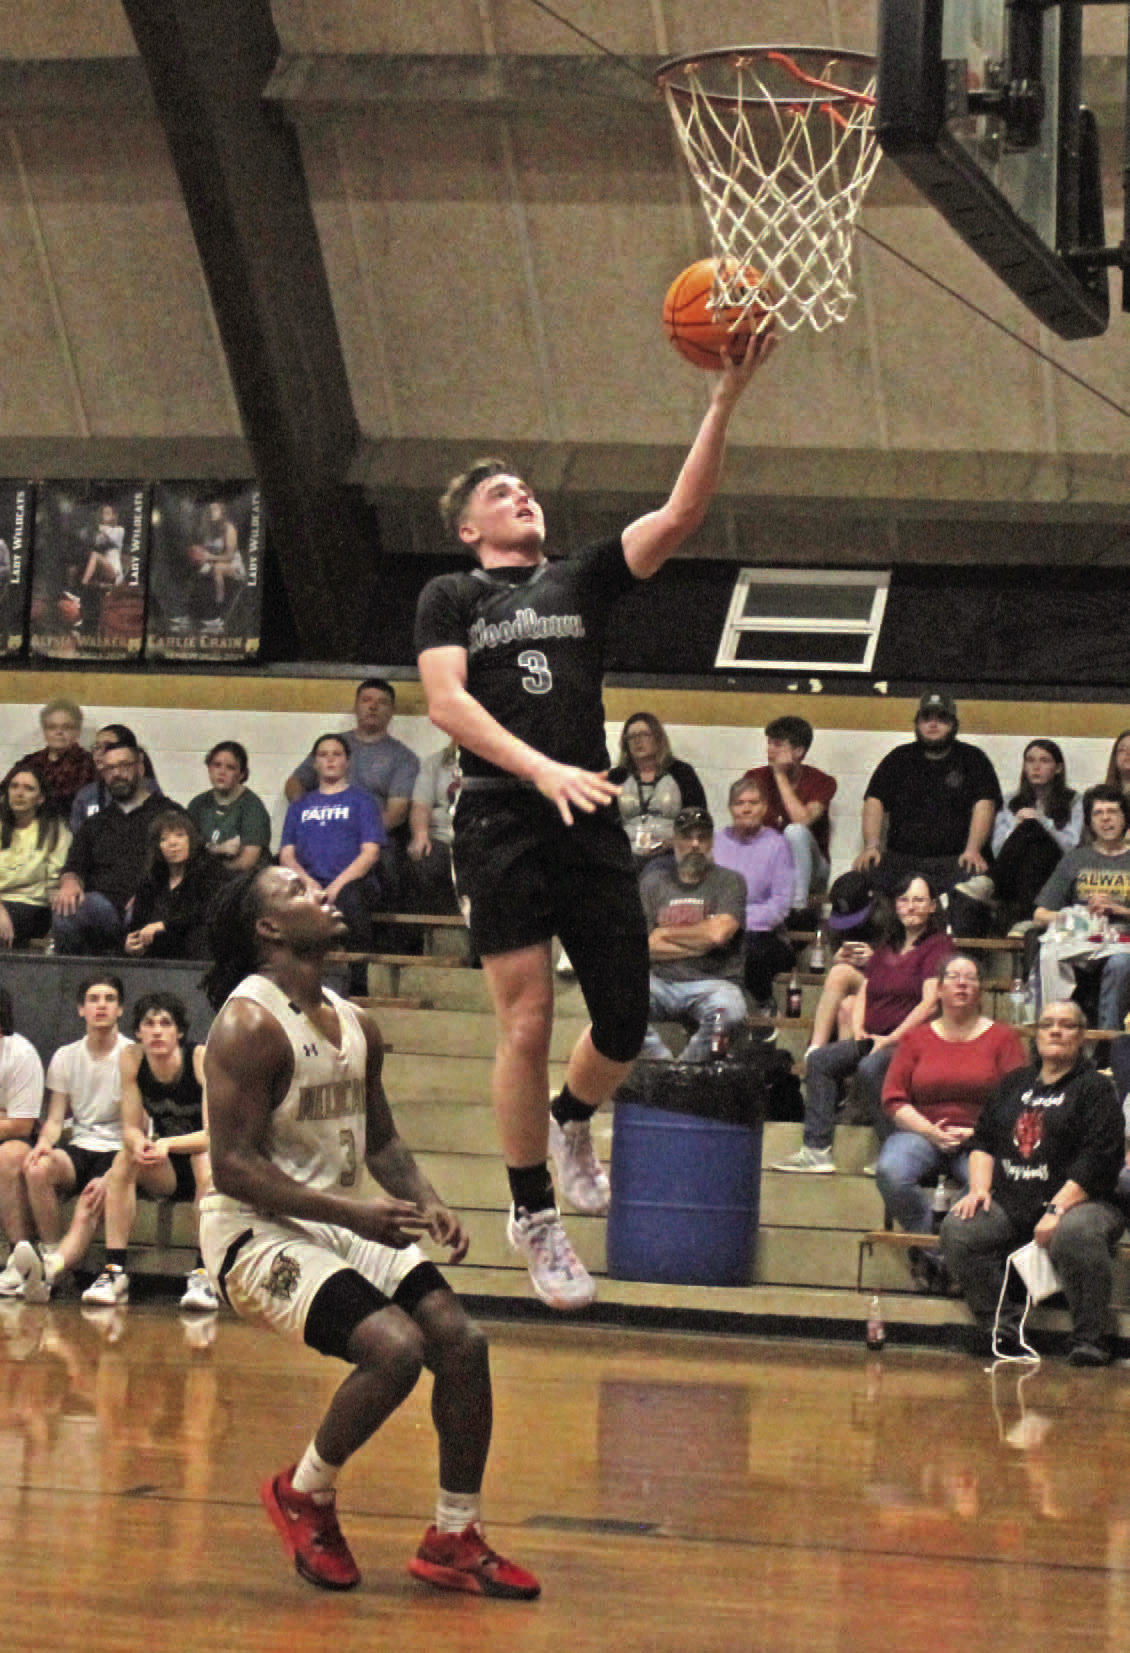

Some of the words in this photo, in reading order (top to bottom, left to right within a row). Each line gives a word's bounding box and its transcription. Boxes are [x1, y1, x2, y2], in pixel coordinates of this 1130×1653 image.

[13, 491, 25, 550] WILDCATS
[11, 554, 21, 584] LADY
[128, 556, 140, 586] LADY
[247, 556, 257, 586] LADY
[517, 650, 552, 694] 3
[301, 807, 349, 823] FAITH
